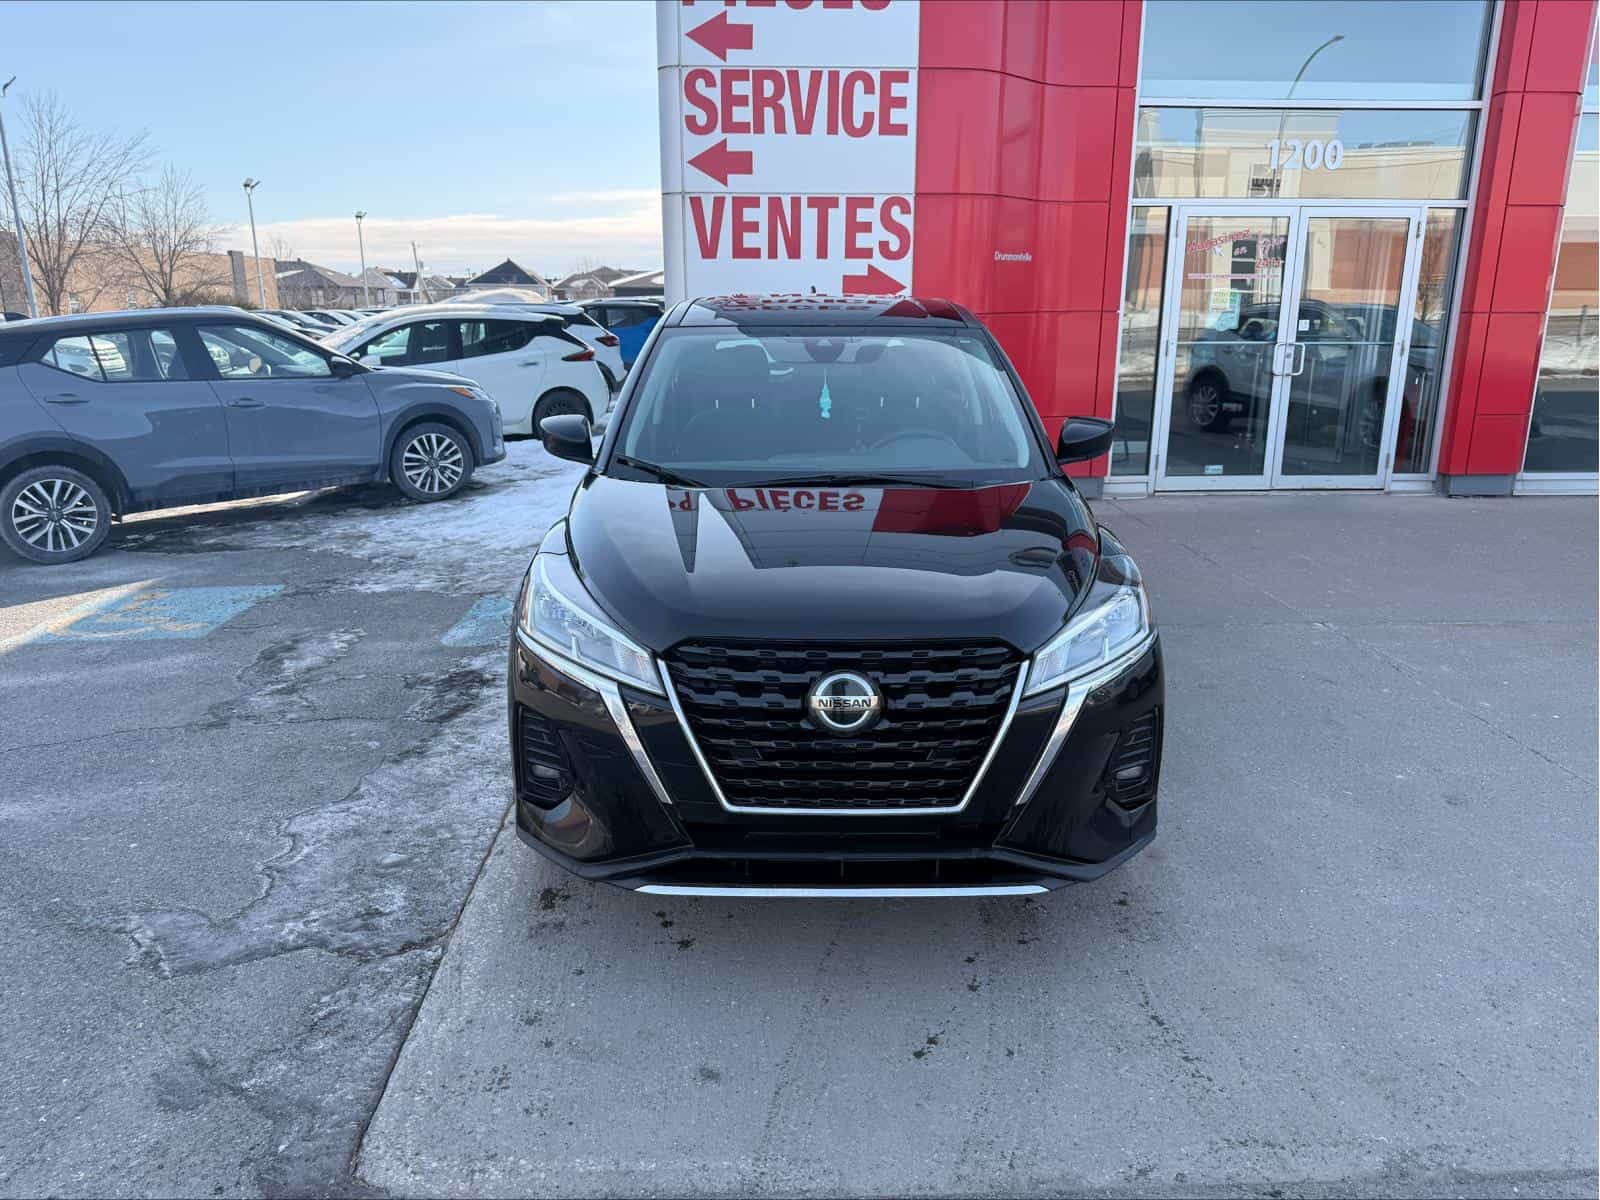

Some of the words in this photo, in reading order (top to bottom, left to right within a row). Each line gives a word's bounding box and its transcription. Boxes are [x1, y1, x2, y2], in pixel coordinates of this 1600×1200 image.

[683, 68, 910, 138] SERVICE
[1264, 138, 1344, 171] 1200
[688, 195, 912, 261] VENTES
[818, 698, 872, 708] NISSAN
